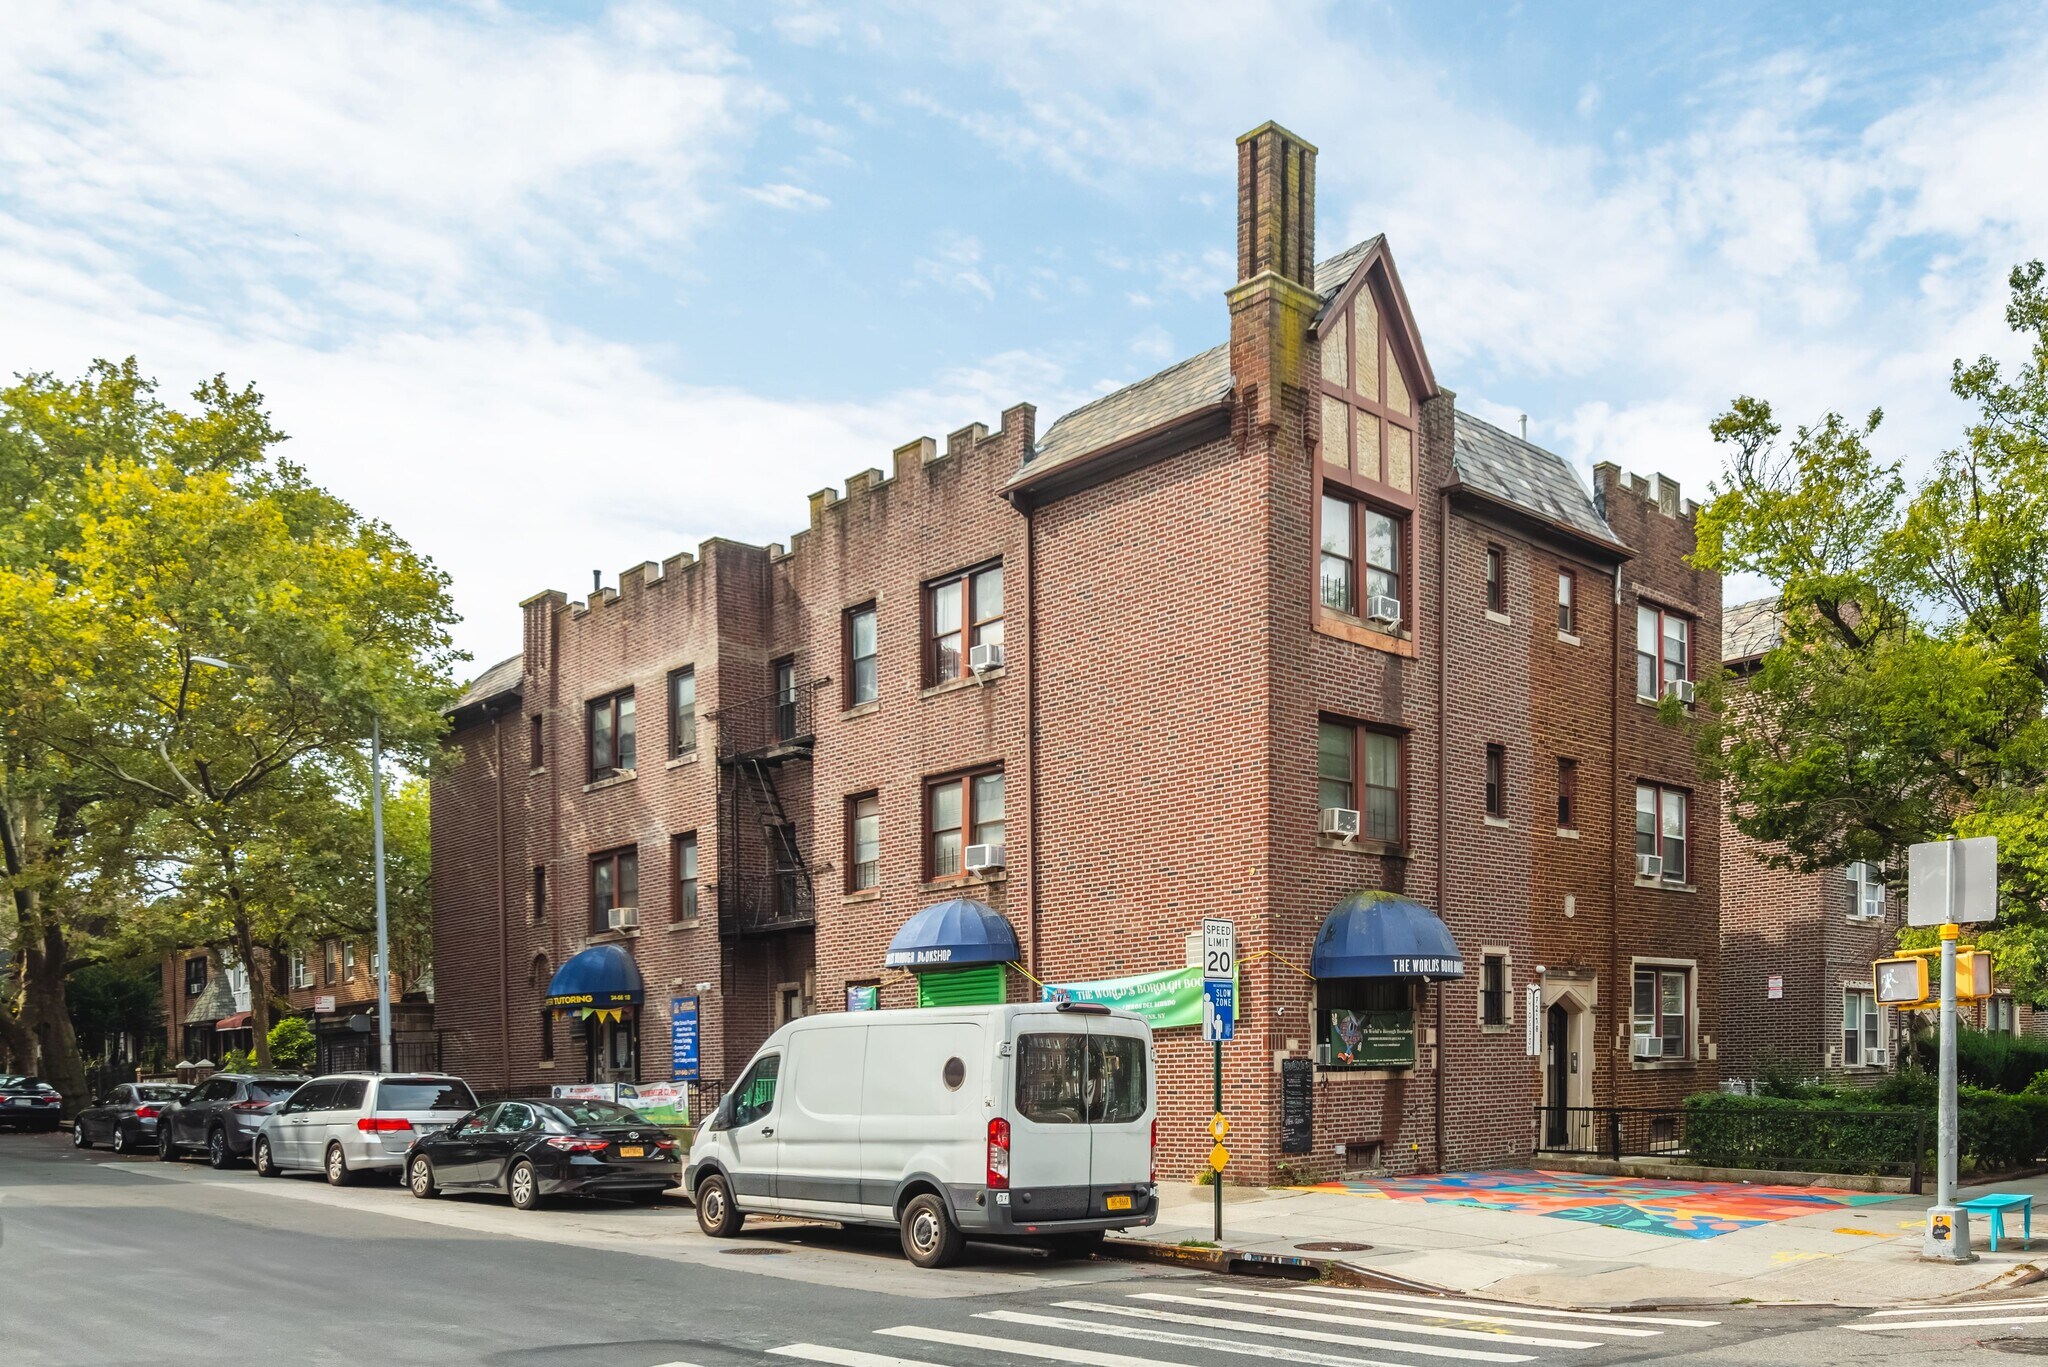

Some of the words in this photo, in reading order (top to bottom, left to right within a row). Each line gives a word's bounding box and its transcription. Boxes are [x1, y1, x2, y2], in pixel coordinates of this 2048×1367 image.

[1206, 924, 1231, 936] SPEED
[1208, 937, 1230, 947] LIMIT
[917, 949, 952, 963] BOOKSHOP
[1207, 951, 1230, 972] 20
[1393, 959, 1410, 973] THE
[1412, 958, 1440, 973] WORLD'S
[1076, 989, 1094, 1000] THE
[1095, 985, 1136, 1000] WORLD'S
[1136, 980, 1182, 996] BOROUGH
[1215, 988, 1232, 998] SLOW
[554, 995, 593, 1005] TUTORING
[1215, 998, 1232, 1007] ZONE
